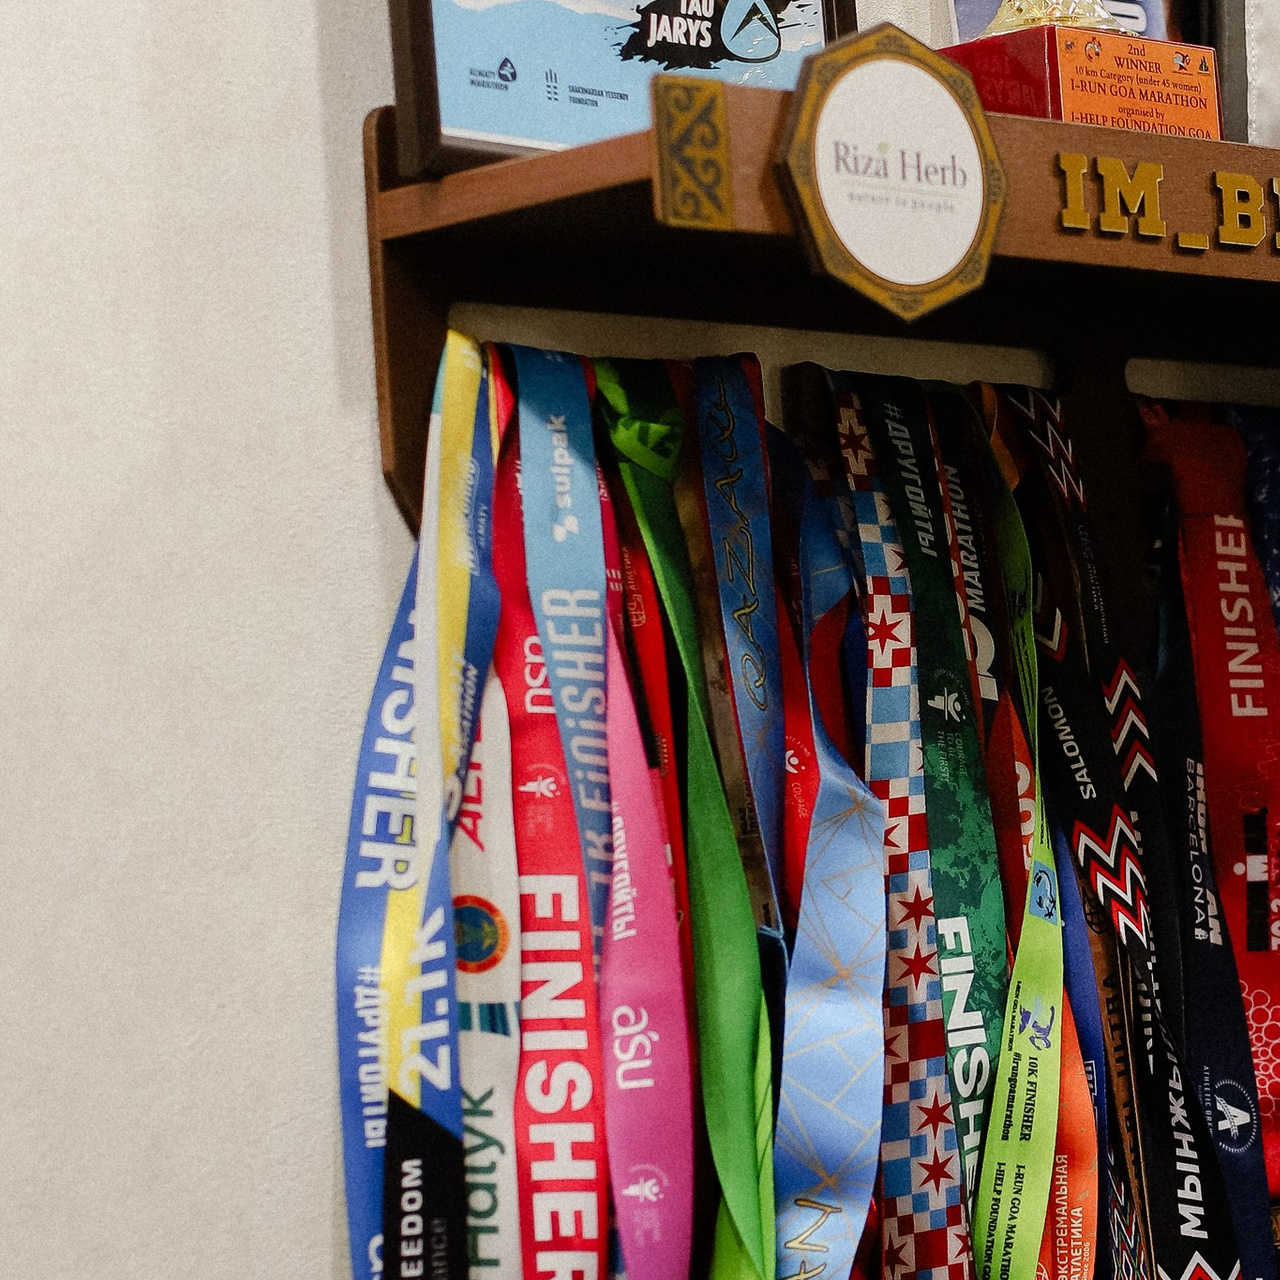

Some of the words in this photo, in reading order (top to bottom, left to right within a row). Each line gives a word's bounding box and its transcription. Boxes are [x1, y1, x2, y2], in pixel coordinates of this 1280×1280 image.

[647, 13, 712, 48] JARYS
[1114, 56, 1163, 74] WINNER
[1128, 44, 1146, 58] 2nd
[1070, 78, 1107, 96] I-RUN
[1110, 84, 1136, 101] GOA
[1138, 89, 1208, 111] MARATHON
[1075, 66, 1084, 76] 10
[1085, 67, 1098, 78] km
[1100, 69, 1135, 85] Category
[1136, 75, 1160, 87] (under
[1162, 79, 1171, 89] 45
[1172, 82, 1202, 95] women)
[1071, 111, 1107, 127] I-HELP
[1111, 115, 1186, 137] FOUNDATION
[1189, 127, 1212, 140] GOA
[1118, 105, 1154, 119] organised
[1155, 110, 1165, 121] by
[900, 149, 968, 188] Herb
[549, 414, 570, 510] sulpak
[884, 402, 938, 558] #ДРУГОЙТЫ
[943, 464, 987, 613] MARATHON
[937, 730, 947, 748] THE
[954, 732, 968, 777] COURAGE
[1041, 685, 1097, 801] SALOMON
[1186, 757, 1208, 924] BARCELONA
[1027, 1056, 1039, 1077] 10K
[1001, 1051, 1022, 1141] #irungoamarathon
[1202, 1065, 1213, 1107] ATHLETIC
[1019, 1079, 1037, 1141] FINISHER
[992, 1162, 1006, 1195] I-HELP
[1012, 1164, 1025, 1194] I-RUN
[1008, 1197, 1022, 1221] GOA
[984, 1197, 1003, 1262] FOUNDATION
[1082, 1241, 1090, 1261] 2006
